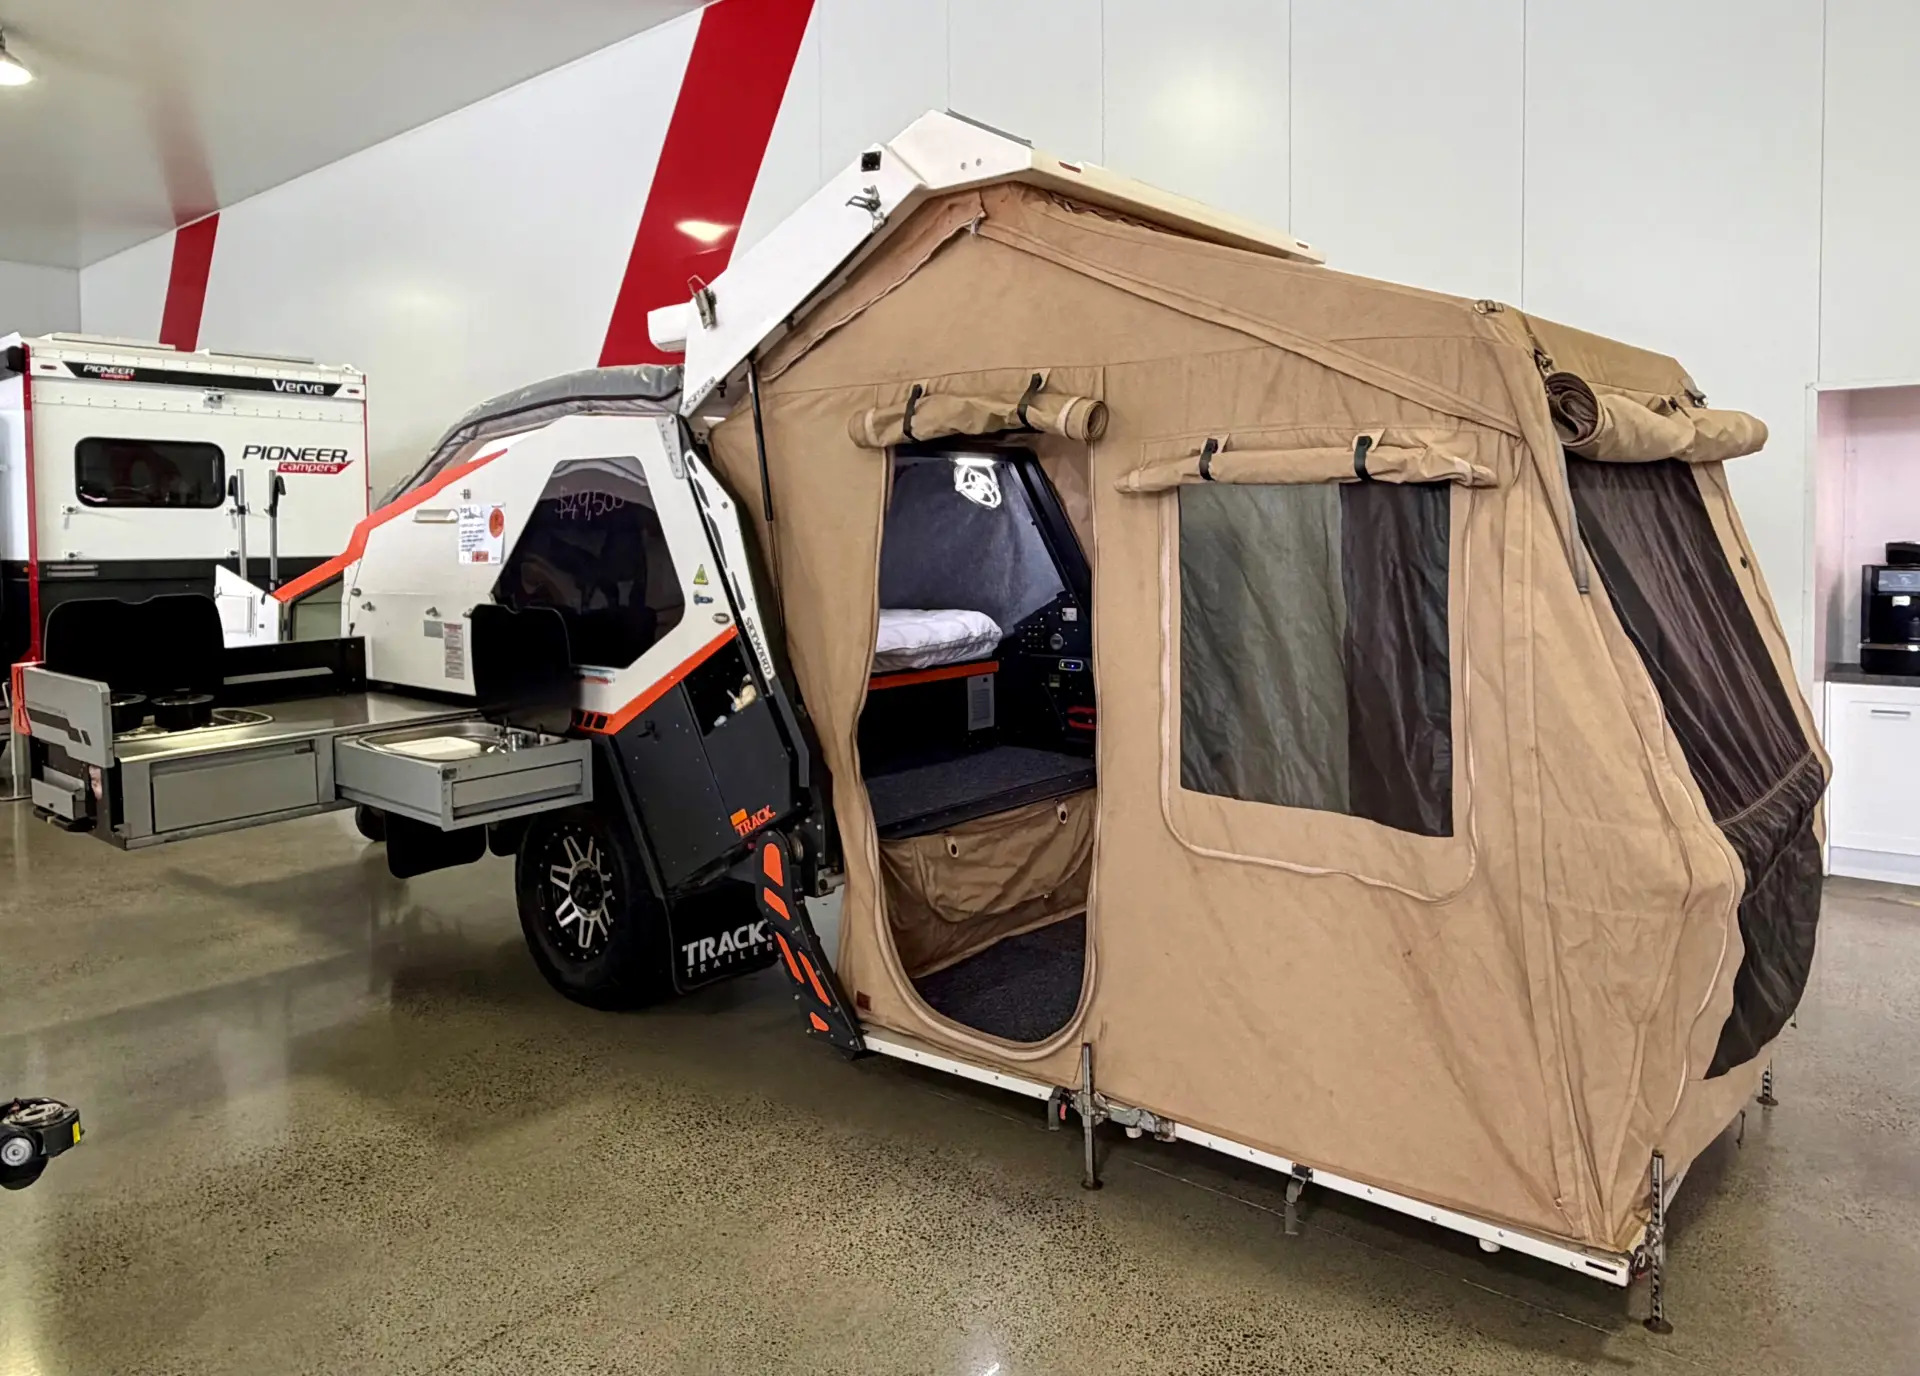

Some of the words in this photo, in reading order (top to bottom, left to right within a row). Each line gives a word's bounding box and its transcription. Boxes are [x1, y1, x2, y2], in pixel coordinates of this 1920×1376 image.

[272, 379, 325, 395] Verve
[242, 444, 349, 463] PIONEER
[279, 462, 338, 473] campers
[686, 942, 774, 978] TRAILER
